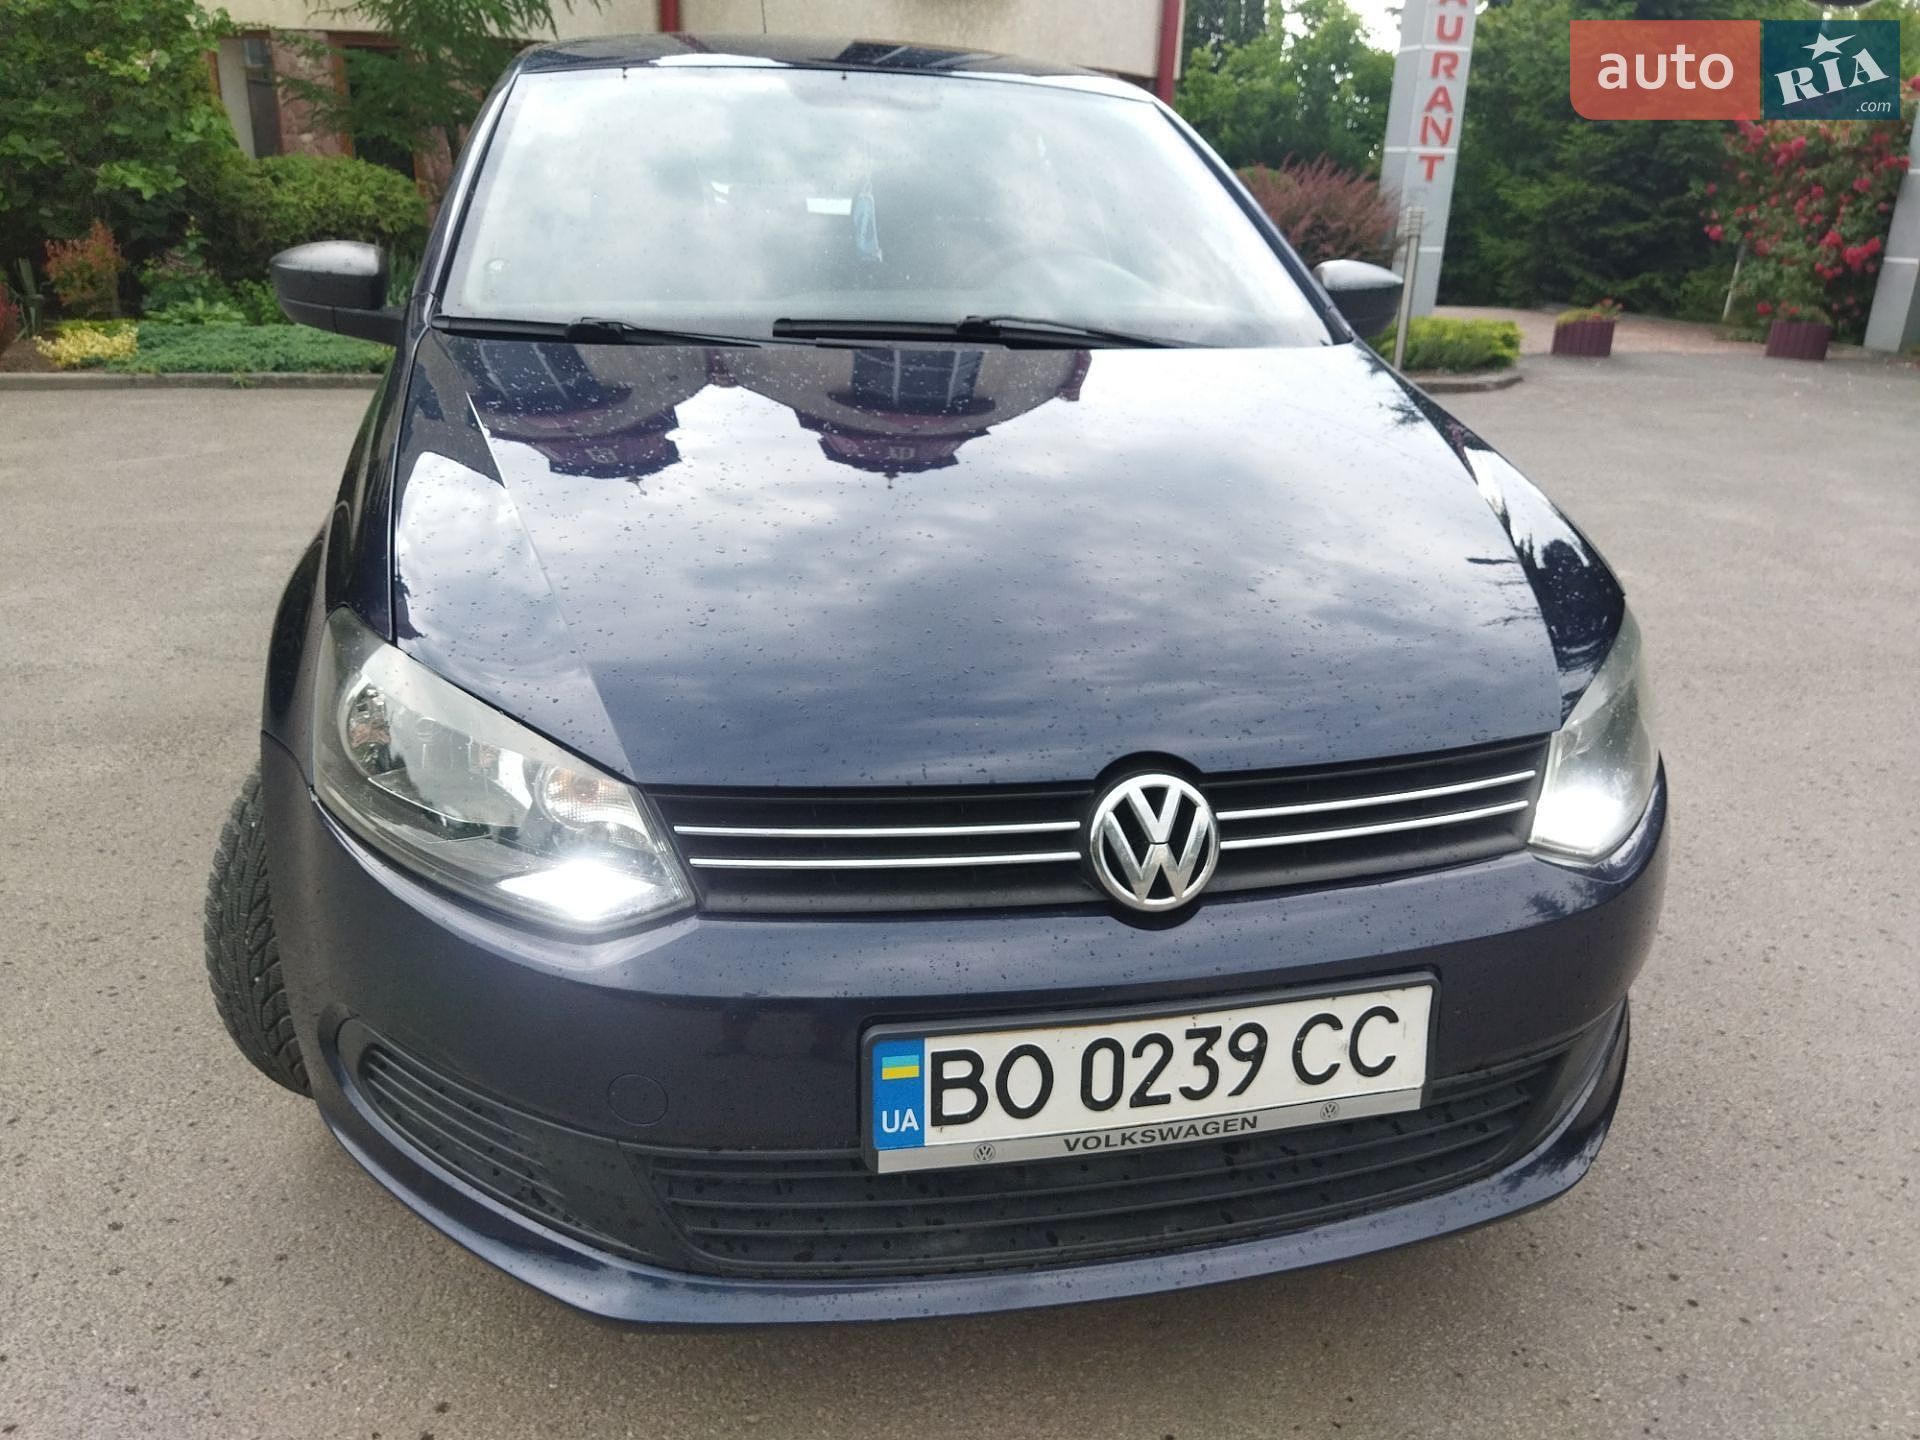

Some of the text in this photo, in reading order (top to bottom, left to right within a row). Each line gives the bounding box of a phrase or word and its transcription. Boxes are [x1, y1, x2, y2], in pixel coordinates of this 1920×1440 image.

[1418, 0, 1468, 183] URANT
[1091, 774, 1219, 911] VW
[881, 1108, 919, 1133] UA
[930, 1005, 1399, 1127] BO 0239 CC
[1062, 1114, 1258, 1153] VOLKSWAGEN
